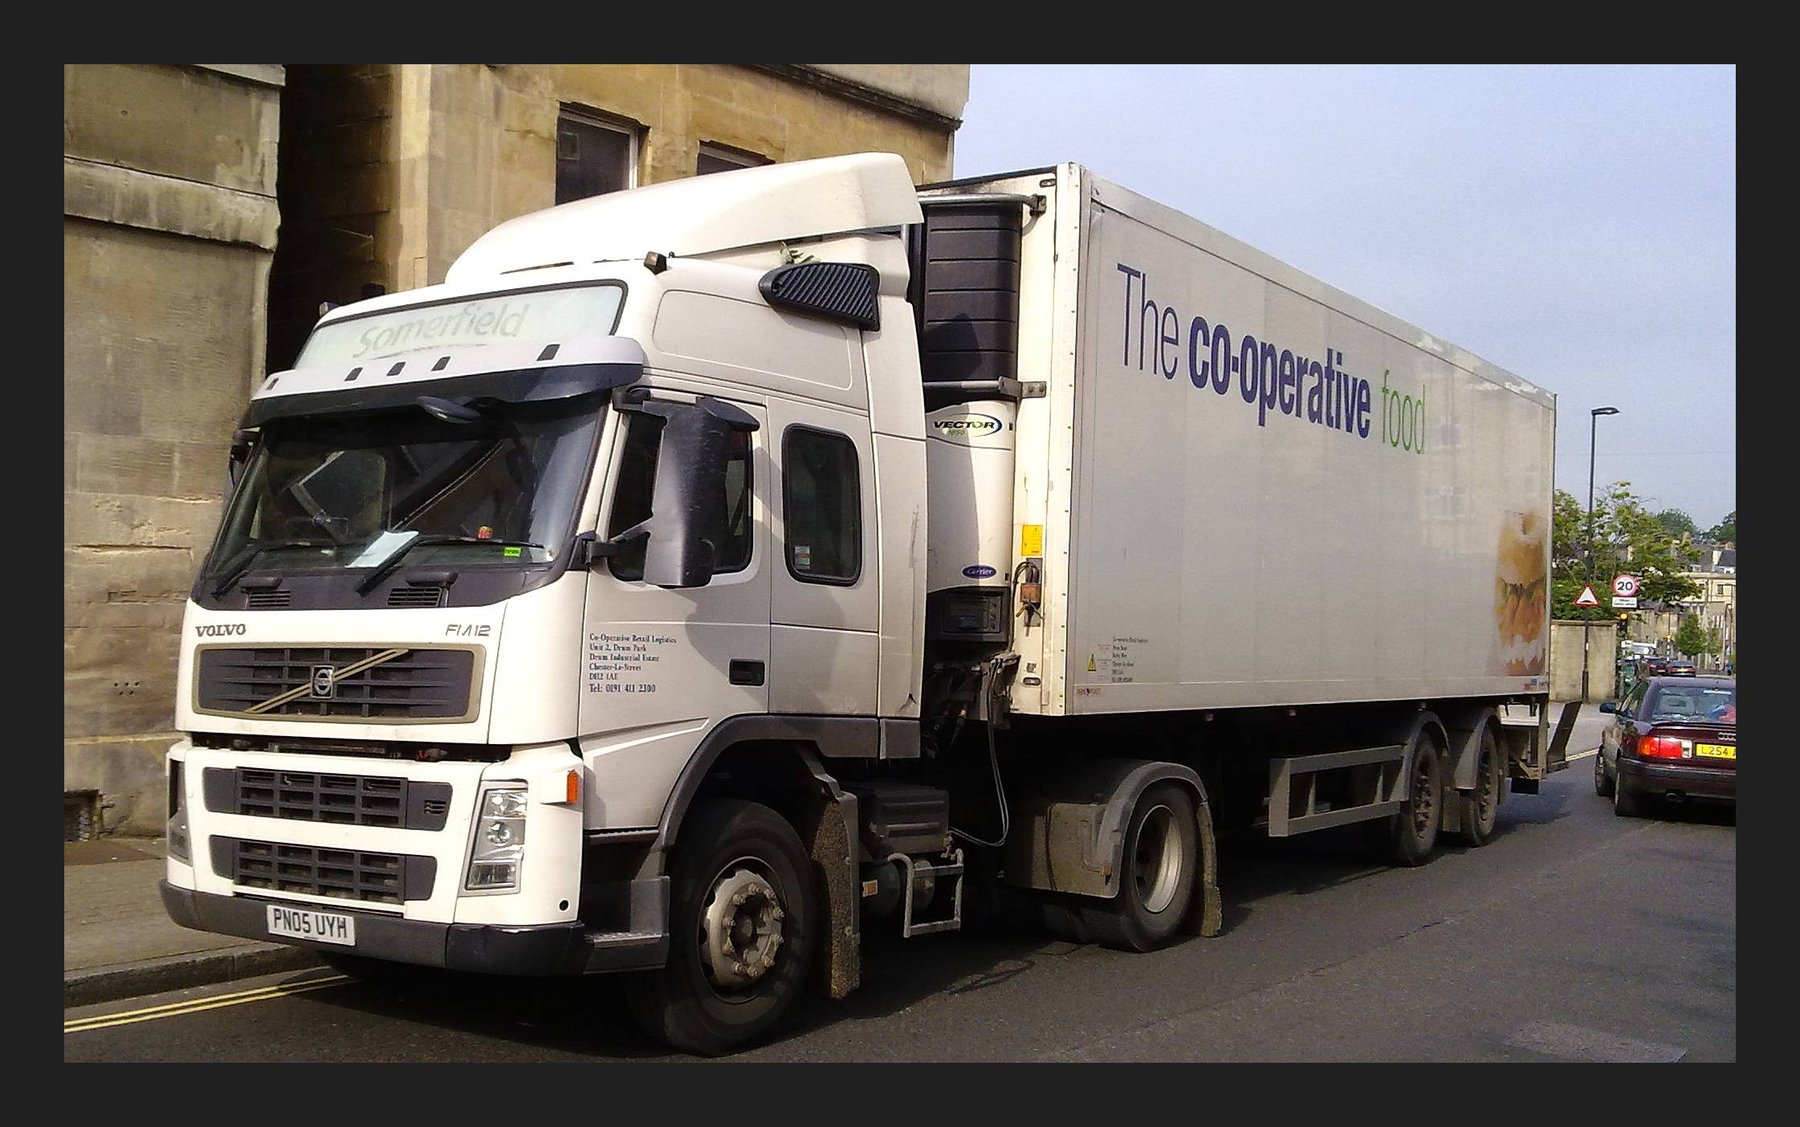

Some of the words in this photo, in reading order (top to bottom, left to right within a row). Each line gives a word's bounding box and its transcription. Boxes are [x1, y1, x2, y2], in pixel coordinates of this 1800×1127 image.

[353, 303, 530, 358] Somerfield
[1117, 263, 1179, 380] The
[1189, 316, 1371, 438] co-operative
[1381, 369, 1425, 454] food
[934, 421, 995, 429] VECTOR
[1617, 582, 1633, 591] 20
[195, 623, 246, 637] VOLVO
[445, 624, 491, 636] FM12
[652, 636, 677, 644] Logistics
[590, 643, 603, 651] Unit
[590, 653, 608, 661] Drum
[590, 684, 603, 693] Tel:
[605, 684, 621, 693] 0191
[624, 684, 635, 693] 411
[638, 684, 656, 693] 2300
[1701, 746, 1729, 756] L254
[273, 908, 311, 934] PN05
[315, 914, 347, 939] UYH
